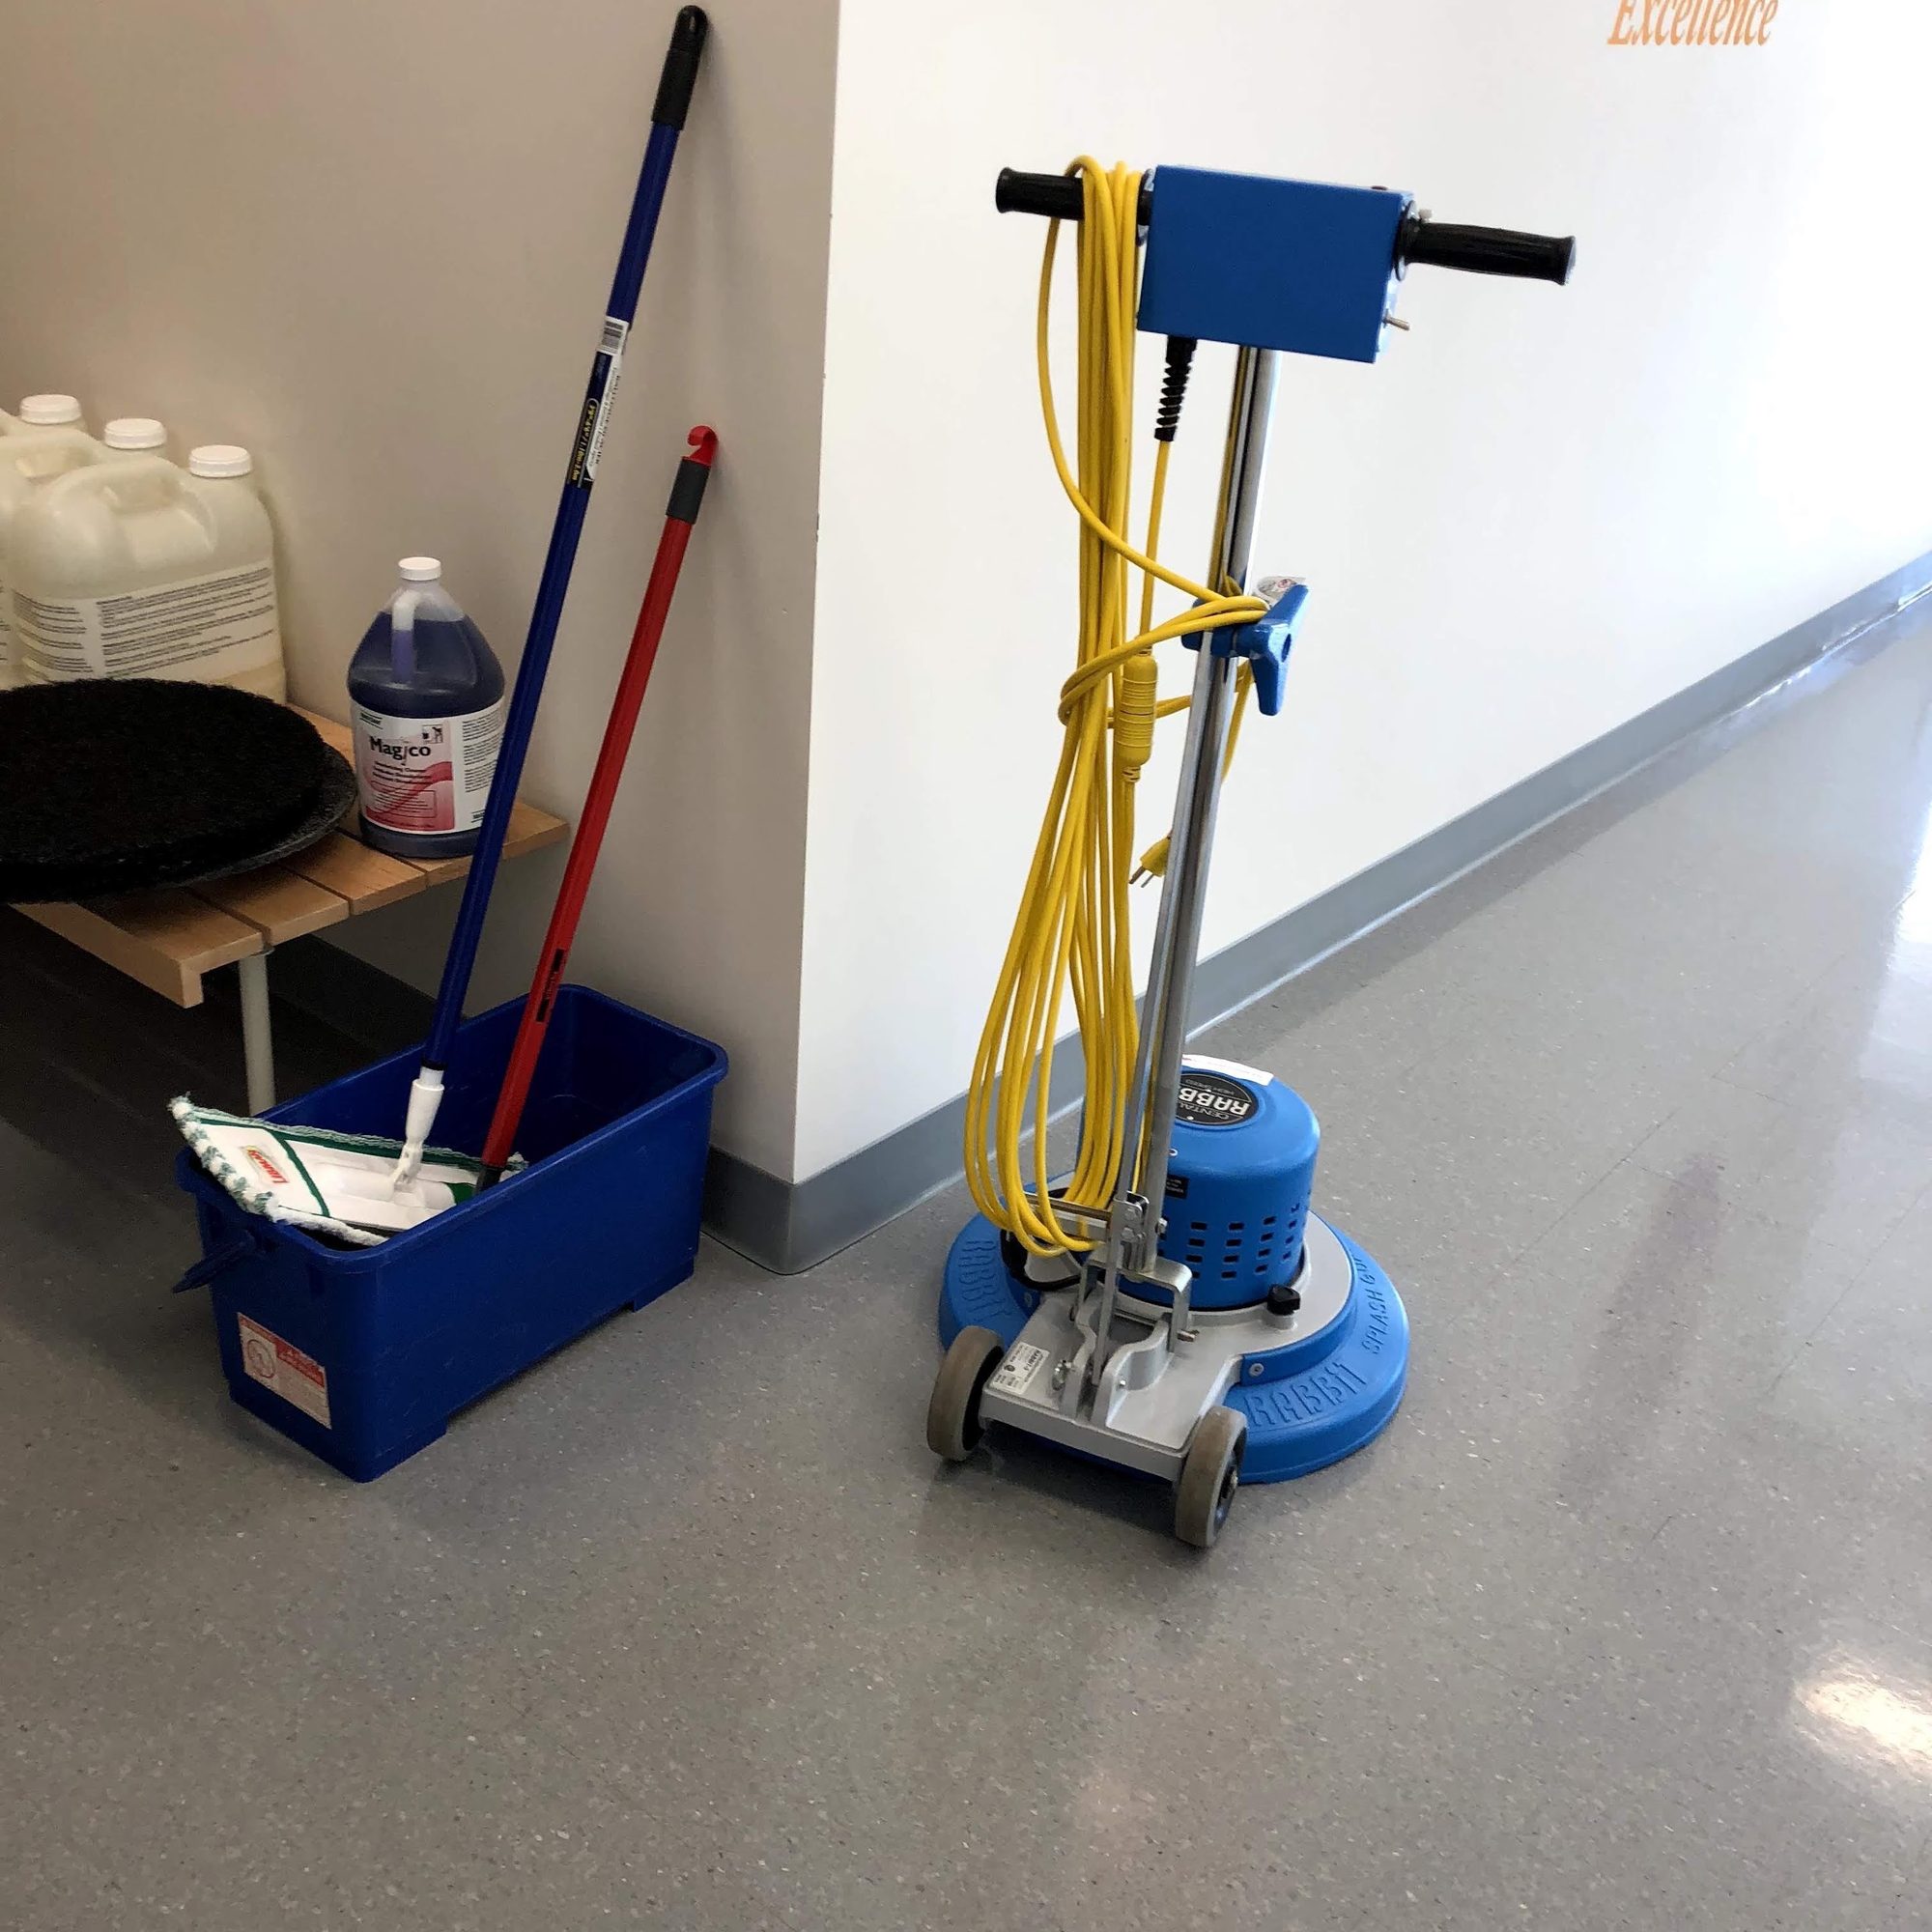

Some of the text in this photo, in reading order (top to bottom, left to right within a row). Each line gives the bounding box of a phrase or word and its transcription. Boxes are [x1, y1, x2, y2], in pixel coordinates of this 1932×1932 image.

[1607, 0, 1778, 46] Excellence
[369, 735, 432, 763] Magico
[1178, 1102, 1230, 1120] CENTA
[1179, 1087, 1250, 1116] RABB
[1360, 1288, 1389, 1355] SPLASH
[1243, 1361, 1368, 1427] RABBIT
